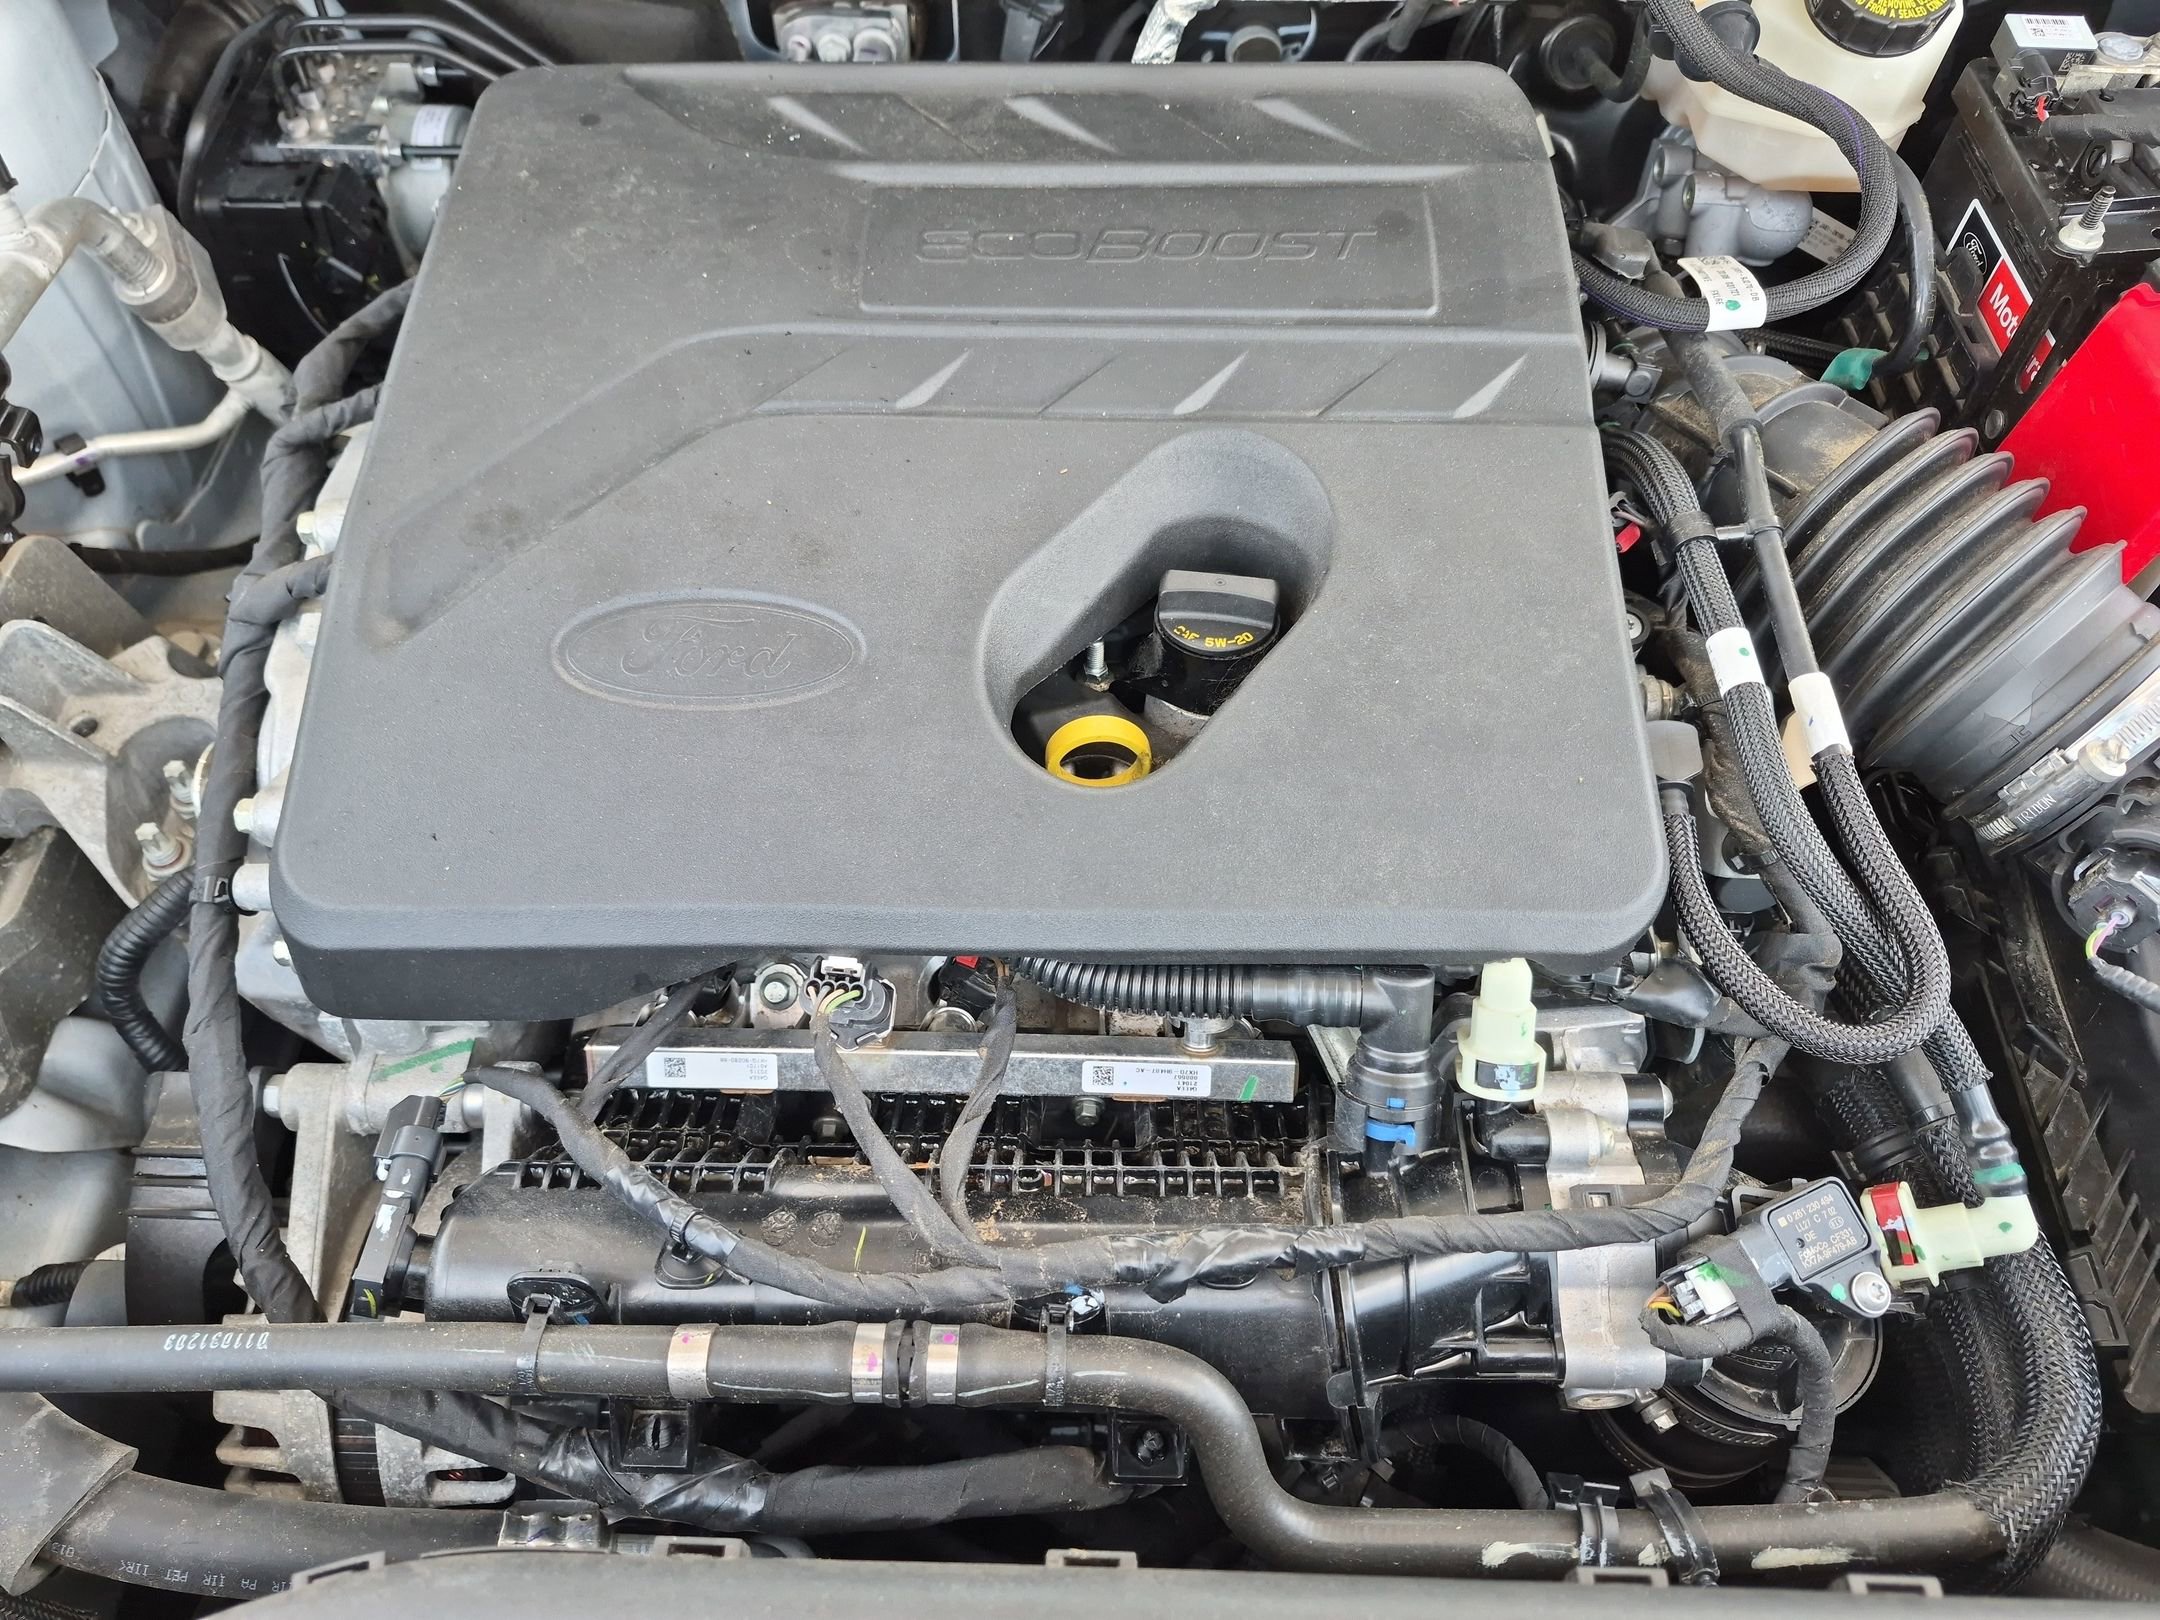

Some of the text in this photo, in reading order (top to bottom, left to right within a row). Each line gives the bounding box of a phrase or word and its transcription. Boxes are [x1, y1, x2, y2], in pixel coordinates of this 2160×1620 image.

[1864, 1, 1888, 16] FROM
[1889, 8, 1896, 18] A
[1898, 6, 1927, 19] SEALED
[620, 614, 800, 678] Ford
[1204, 631, 1254, 648] 5W-20
[2015, 794, 2057, 825] TRIDON
[1793, 1208, 1807, 1220] 261
[1806, 1200, 1820, 1213] 230
[1798, 1227, 1854, 1260] FoMoCo CF331
[1804, 1230, 1818, 1242] DE
[164, 1569, 190, 1583] PET
[240, 1578, 258, 1591] PA
